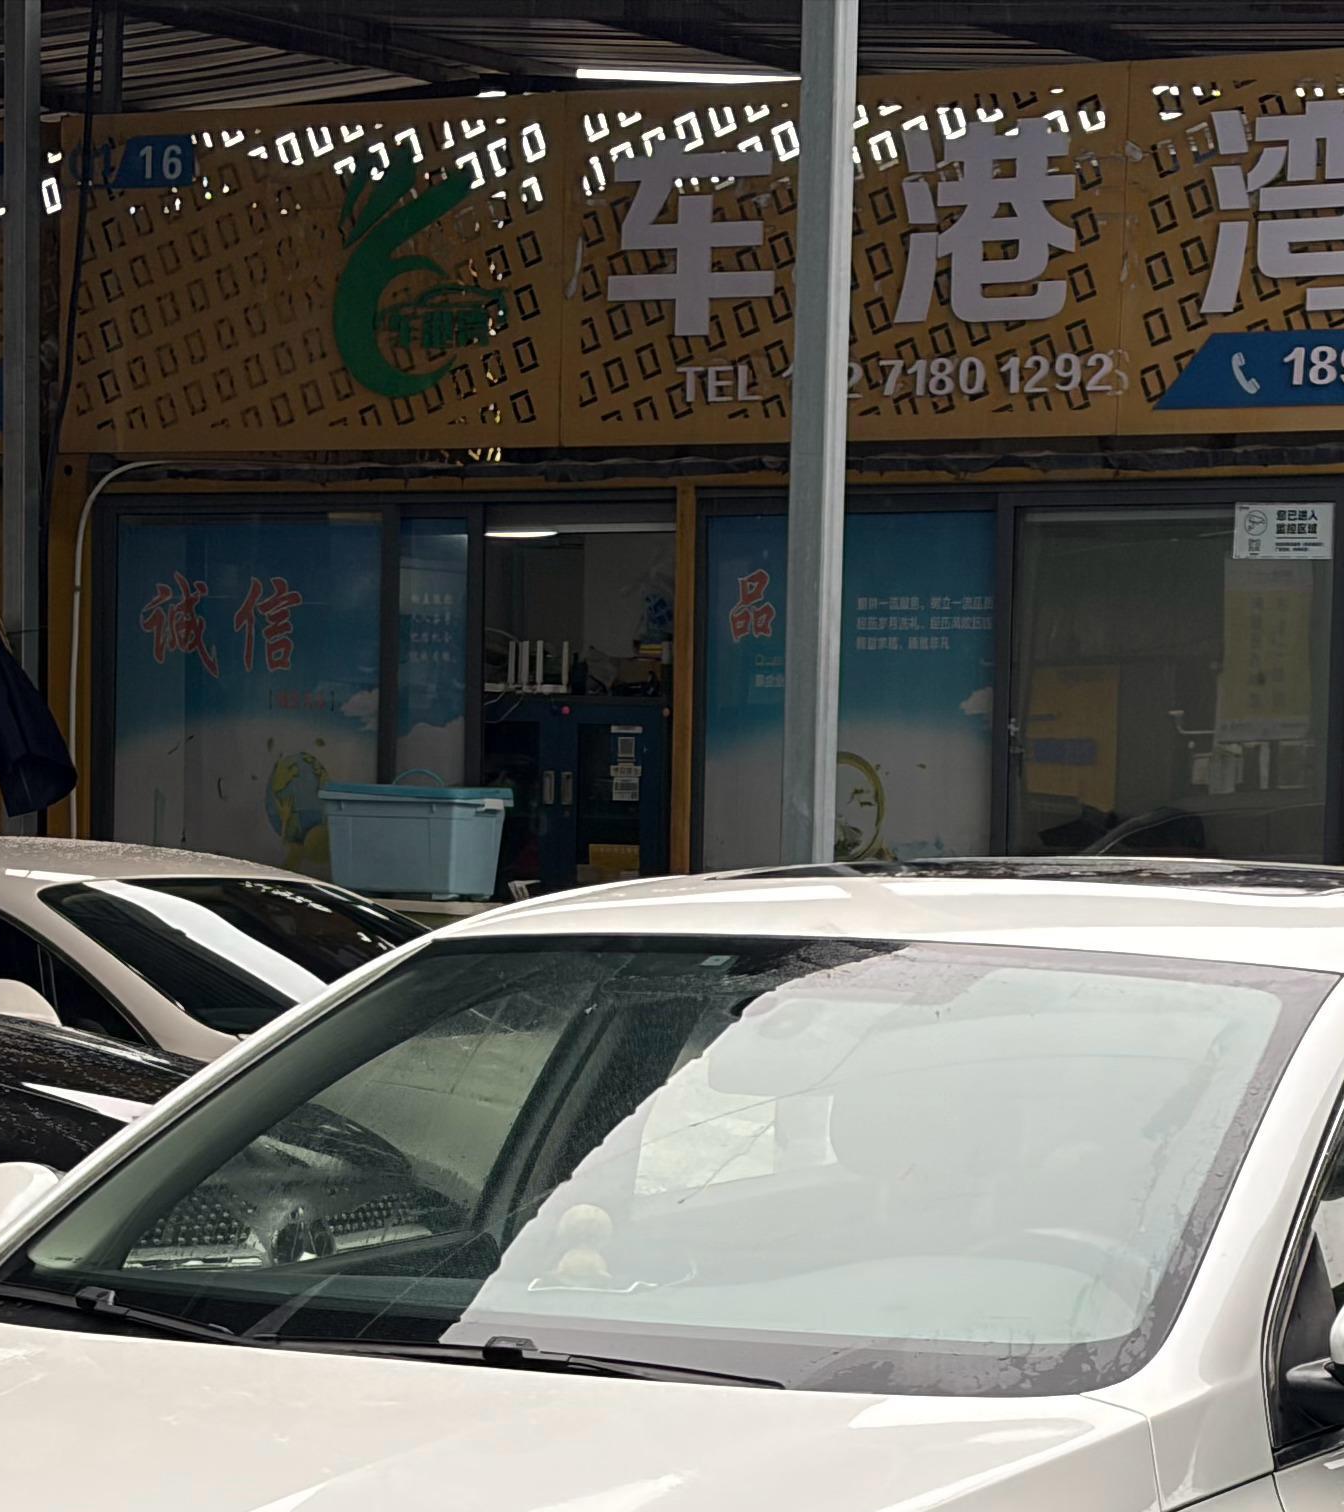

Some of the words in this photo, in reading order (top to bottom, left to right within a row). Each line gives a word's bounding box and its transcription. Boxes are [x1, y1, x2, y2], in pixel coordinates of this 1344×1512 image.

[140, 145, 183, 180] 16
[676, 365, 763, 403] TEL
[879, 356, 987, 397] 7180
[999, 352, 1115, 395] 1292
[729, 569, 777, 643] 品
